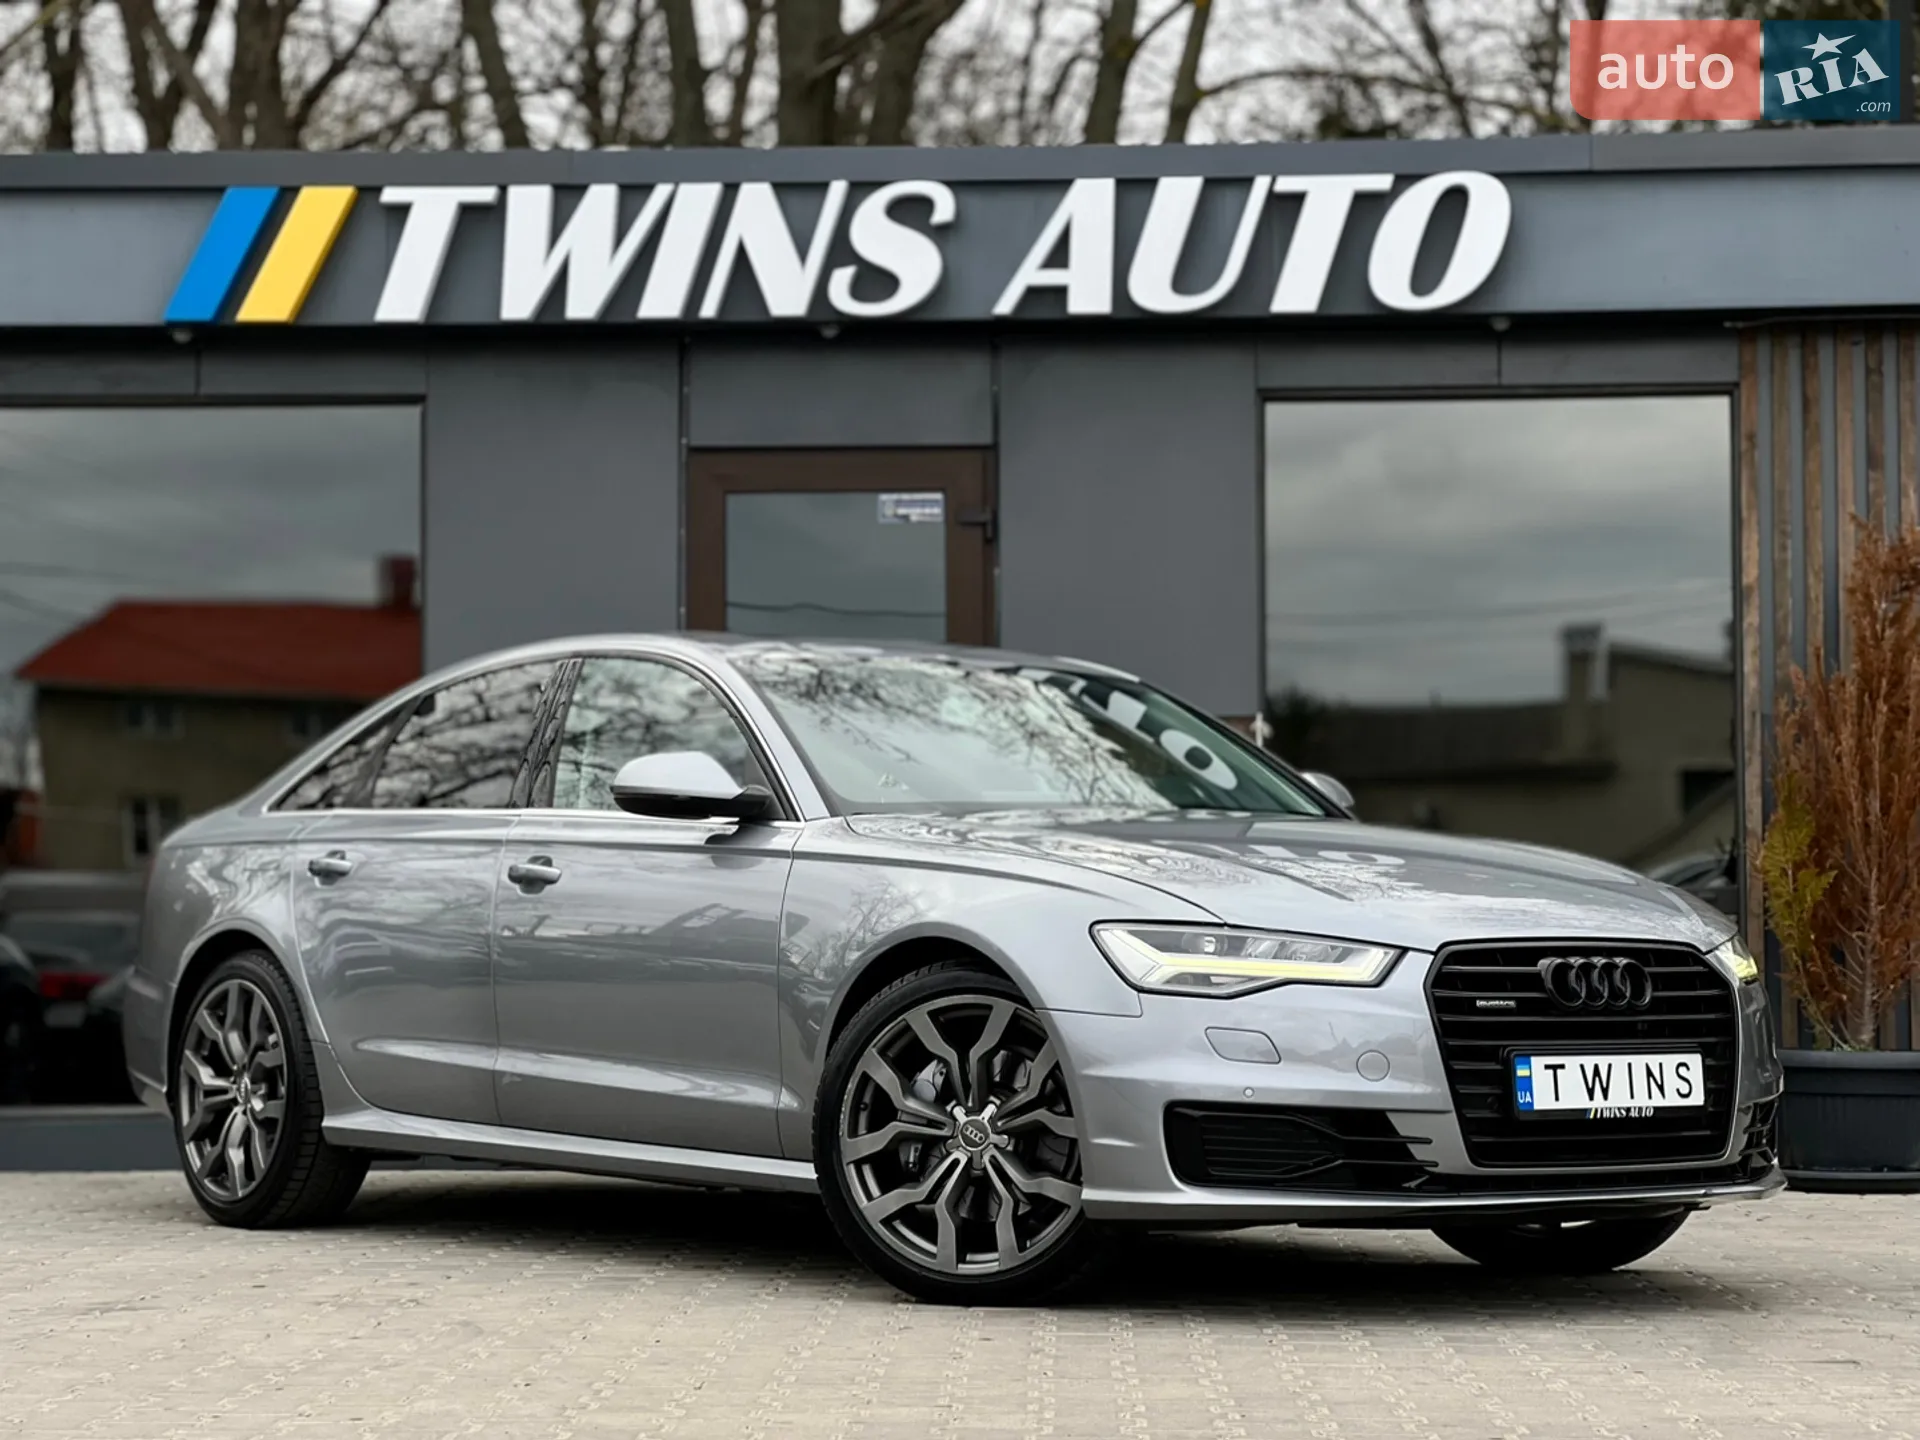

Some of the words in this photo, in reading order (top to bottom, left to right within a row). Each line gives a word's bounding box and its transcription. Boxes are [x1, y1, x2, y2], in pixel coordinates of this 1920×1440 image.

[374, 180, 957, 323] TWINS
[992, 170, 1512, 315] AUTO
[1544, 1062, 1693, 1102] TWINS
[1518, 1091, 1532, 1103] UA
[1628, 1106, 1655, 1118] AUTO
